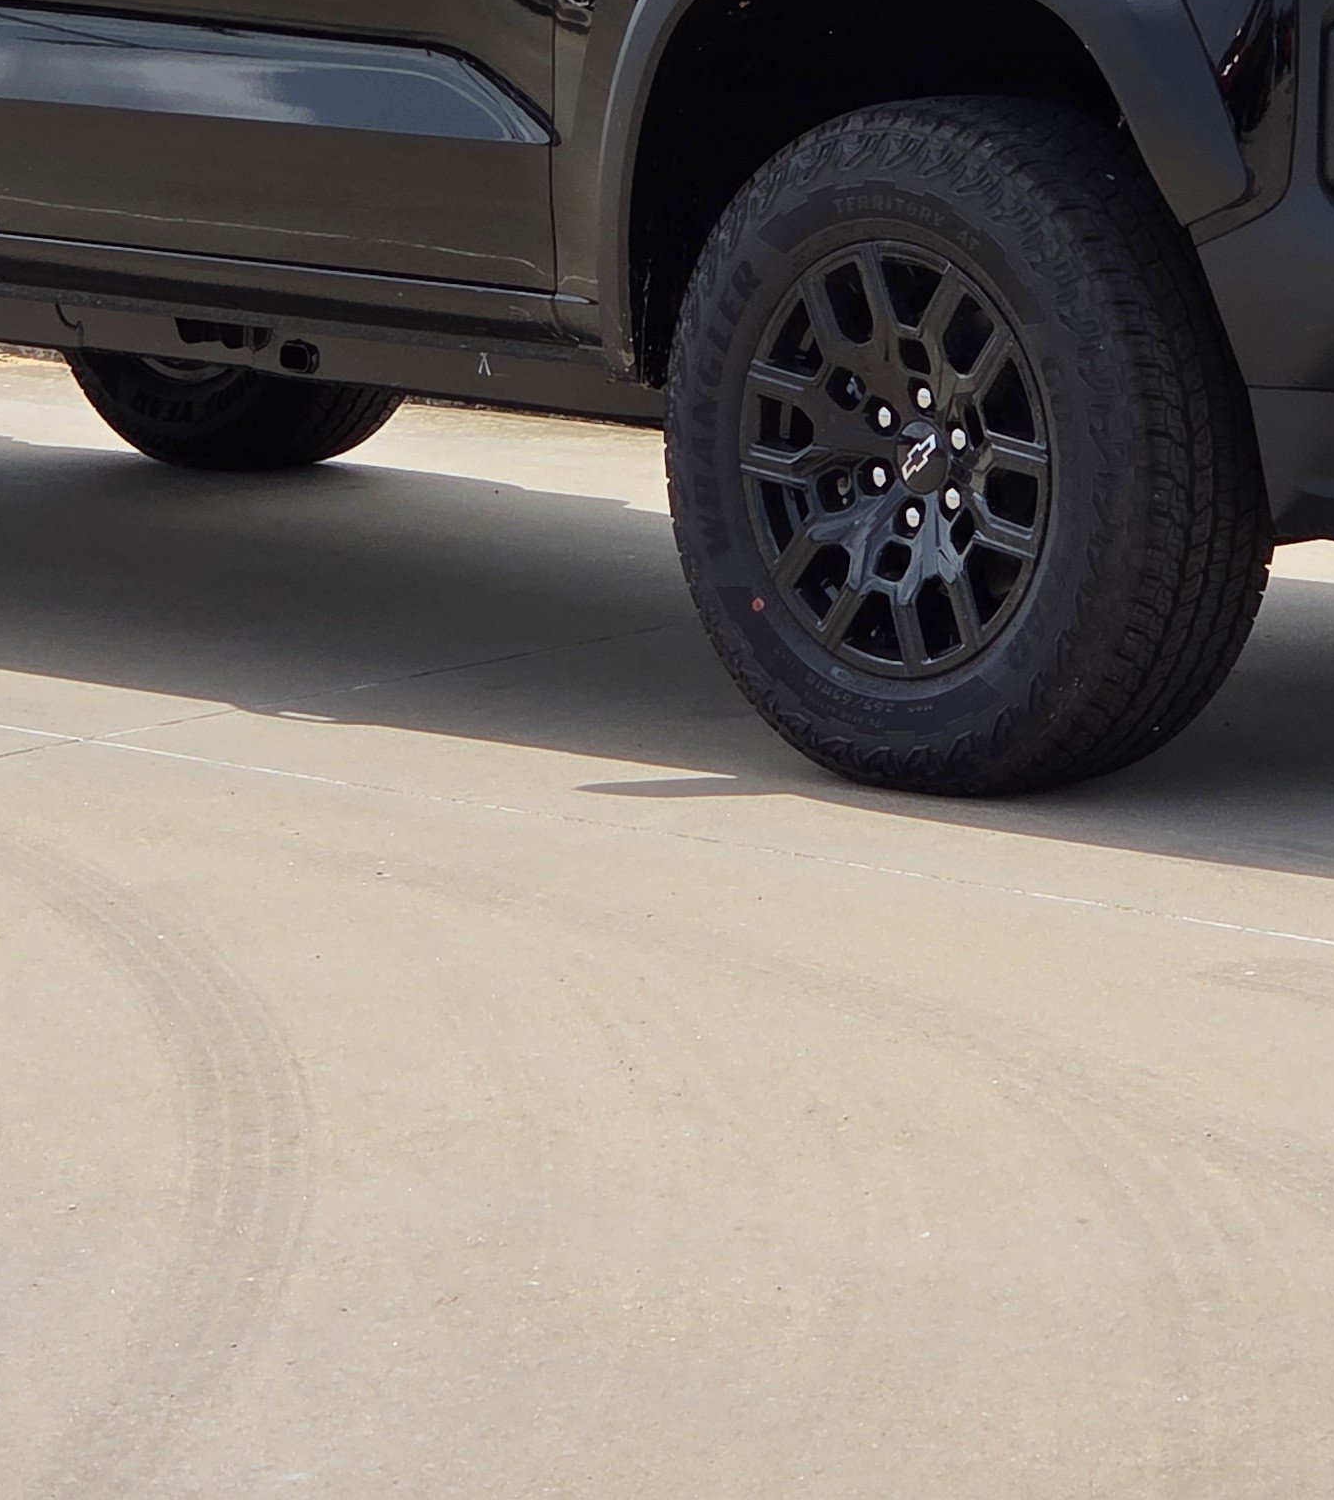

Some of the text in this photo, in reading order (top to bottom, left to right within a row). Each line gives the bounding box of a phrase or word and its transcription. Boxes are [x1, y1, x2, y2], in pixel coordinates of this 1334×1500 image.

[832, 194, 982, 251] TERRITORY AT
[691, 259, 762, 561] WRANGLER
